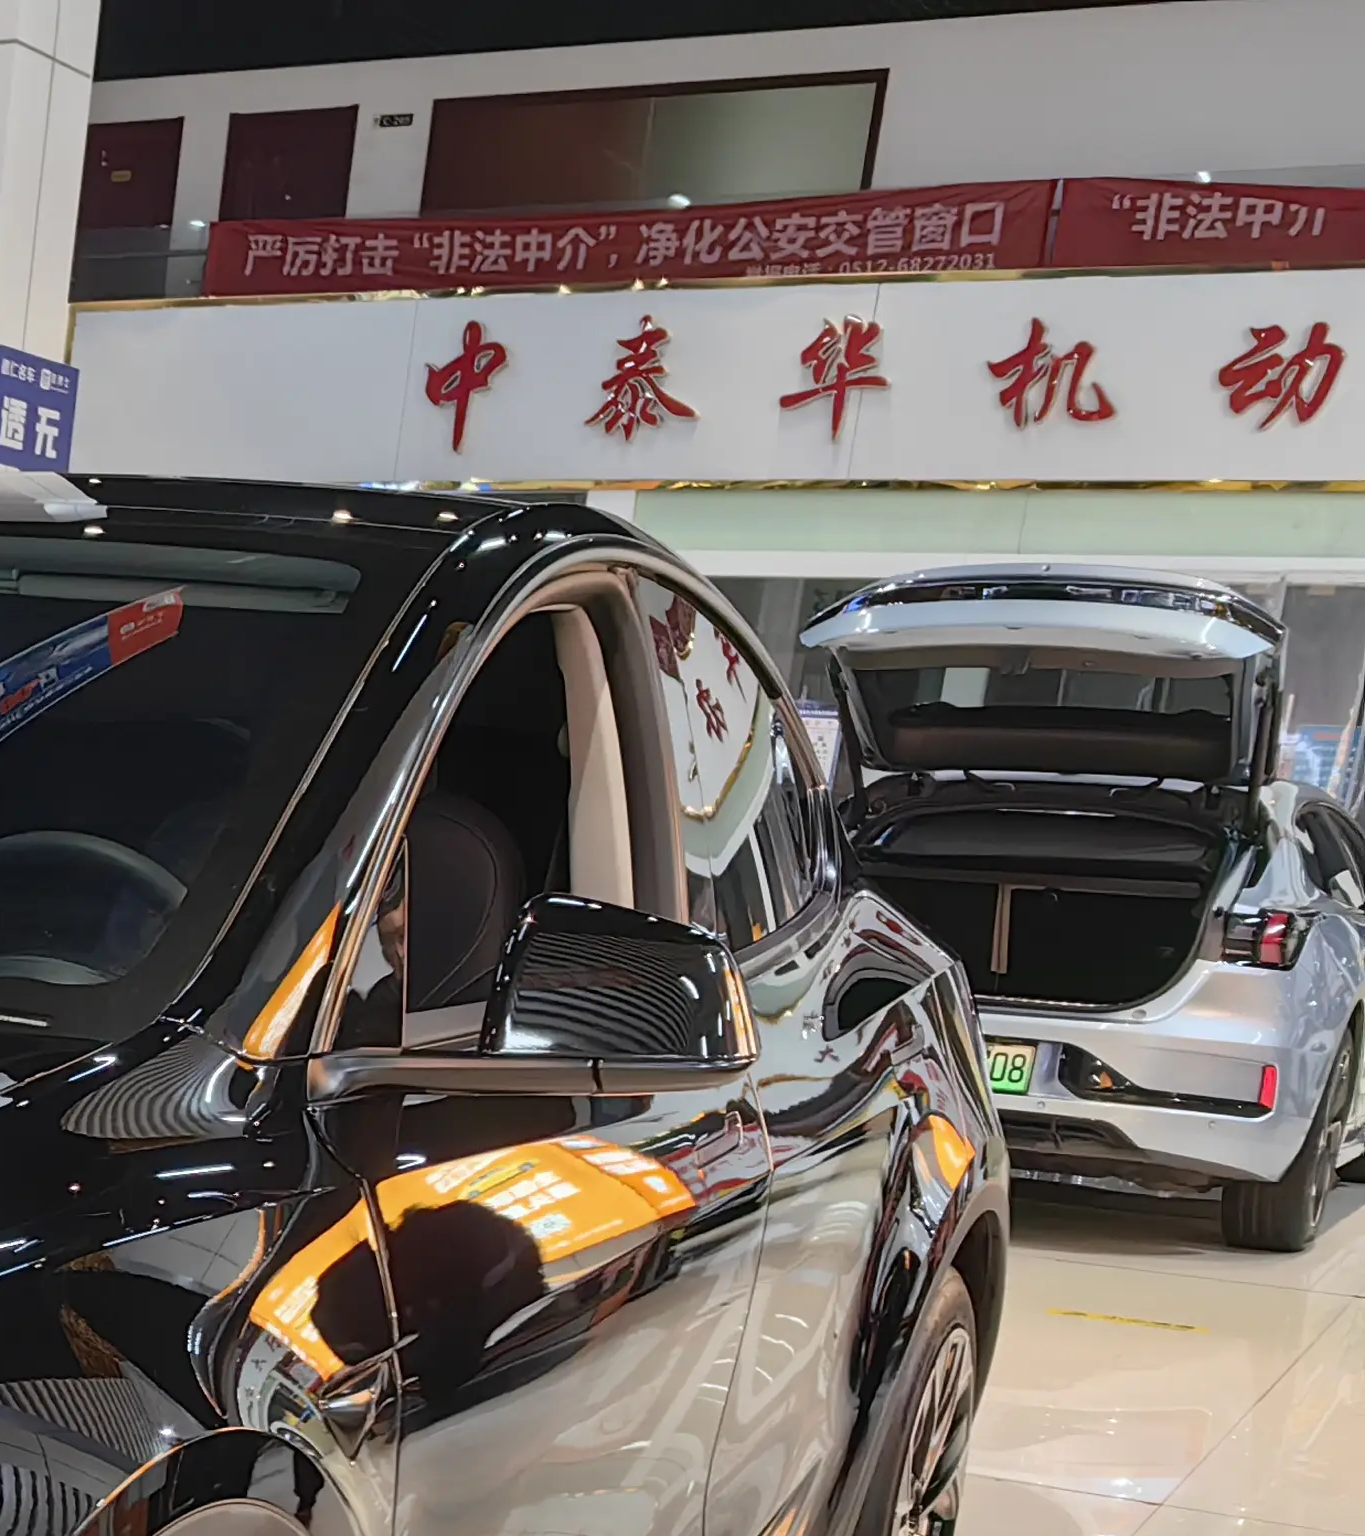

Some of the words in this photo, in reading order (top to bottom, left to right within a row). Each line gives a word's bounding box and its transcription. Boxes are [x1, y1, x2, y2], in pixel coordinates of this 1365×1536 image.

[425, 314, 1347, 452] 中泰华机动
[987, 1050, 1027, 1084] 08
